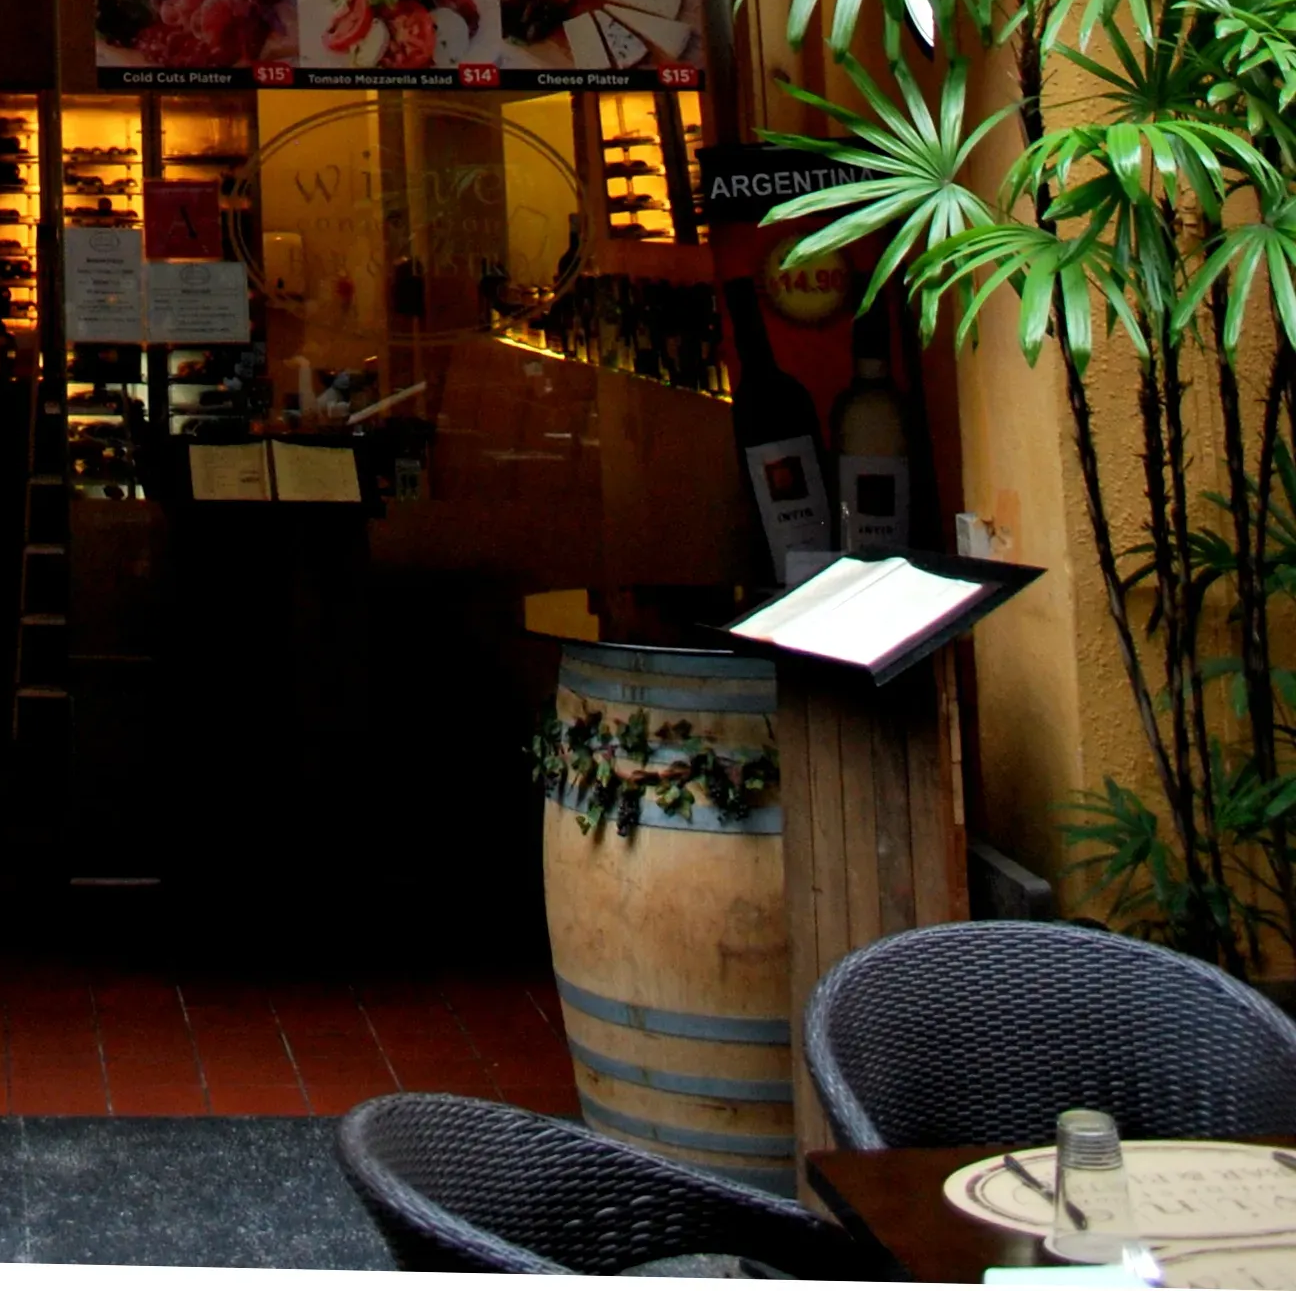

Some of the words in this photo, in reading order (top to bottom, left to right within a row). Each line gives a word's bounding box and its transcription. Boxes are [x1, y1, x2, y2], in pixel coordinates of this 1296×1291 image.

[122, 71, 153, 83] Cold
[156, 72, 186, 84] Cuts
[189, 71, 233, 84] Platter
[308, 73, 352, 85] Tomato
[355, 73, 418, 85] Mozzarella
[420, 74, 453, 85] Salad
[537, 73, 584, 85] Cheese
[587, 73, 630, 85] Platter
